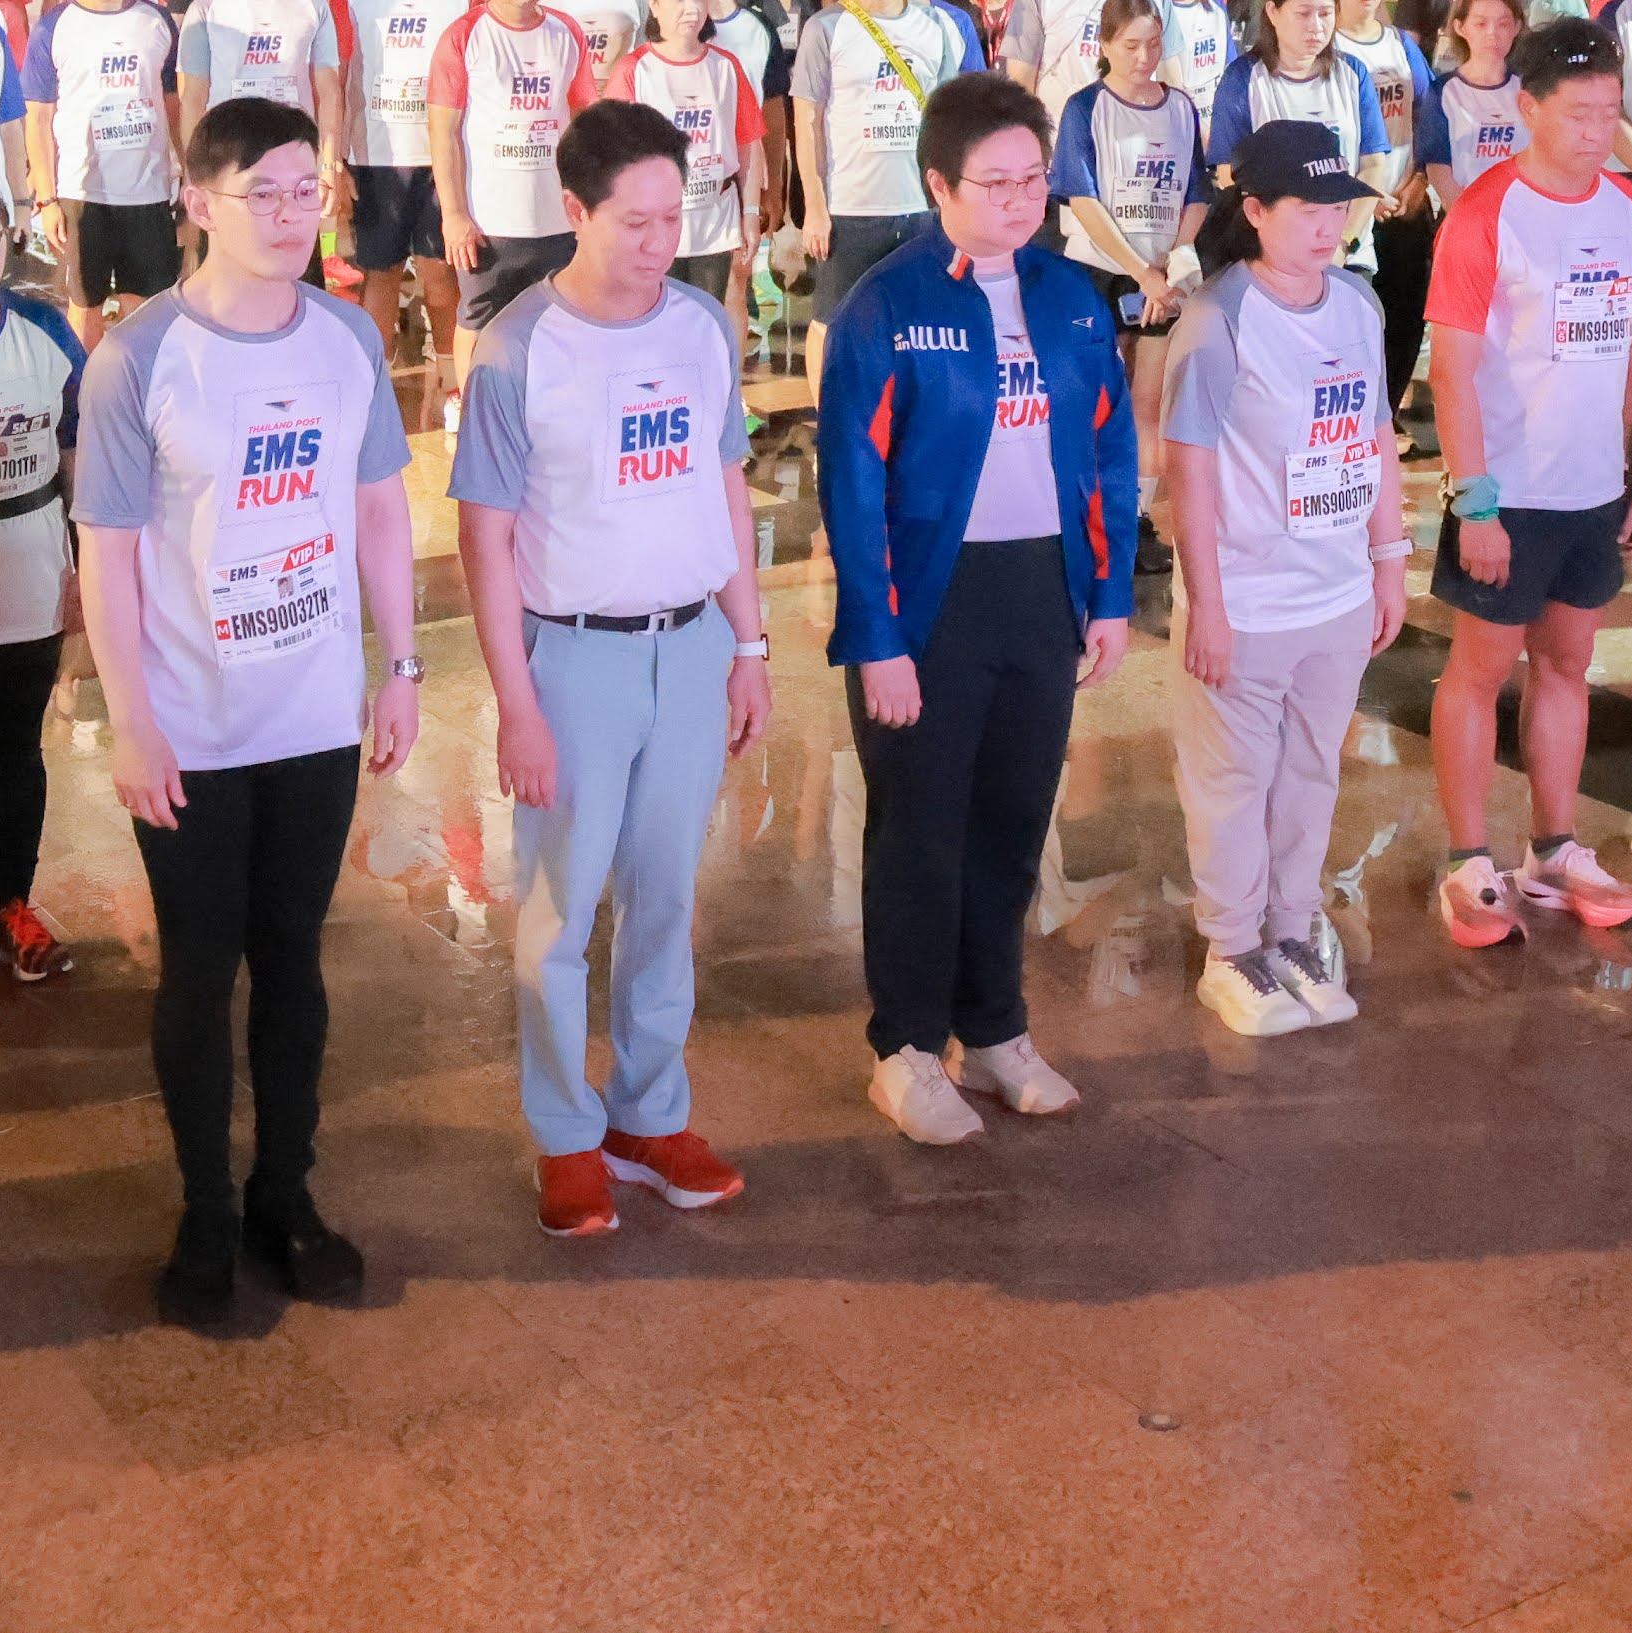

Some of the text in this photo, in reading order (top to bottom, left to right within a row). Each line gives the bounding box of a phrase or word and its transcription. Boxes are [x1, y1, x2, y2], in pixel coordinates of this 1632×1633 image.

[388, 17, 428, 34] EMS
[247, 35, 282, 52] EMS
[385, 35, 424, 49] RUN
[1194, 37, 1216, 57] EMS
[101, 55, 138, 74] EMS
[243, 52, 279, 65] RUN
[1193, 52, 1216, 68] RUN
[512, 76, 551, 95] EMS
[510, 96, 549, 110] RUN
[674, 109, 713, 129] EMS
[1479, 126, 1515, 143] EMS
[1476, 144, 1511, 158] RUN
[1135, 160, 1176, 180] EMS
[1573, 287, 1594, 297] EMS
[1314, 371, 1363, 385] THAILAND POST
[3, 404, 25, 413] POST
[622, 396, 687, 413] THAILAND POST
[1313, 380, 1367, 419] EMS
[11, 419, 30, 435] 5K
[248, 417, 322, 434] THAILAND POST
[620, 407, 690, 453] EMS
[1309, 414, 1361, 448] RUN
[243, 429, 322, 476] EMS
[1305, 447, 1363, 468] EMS VIP
[618, 445, 688, 486] RUN
[237, 470, 315, 509] RUN
[1303, 483, 1373, 518] EMS90037TH
[229, 548, 313, 582] EMS VIP
[231, 587, 330, 641] EMS90032TH
